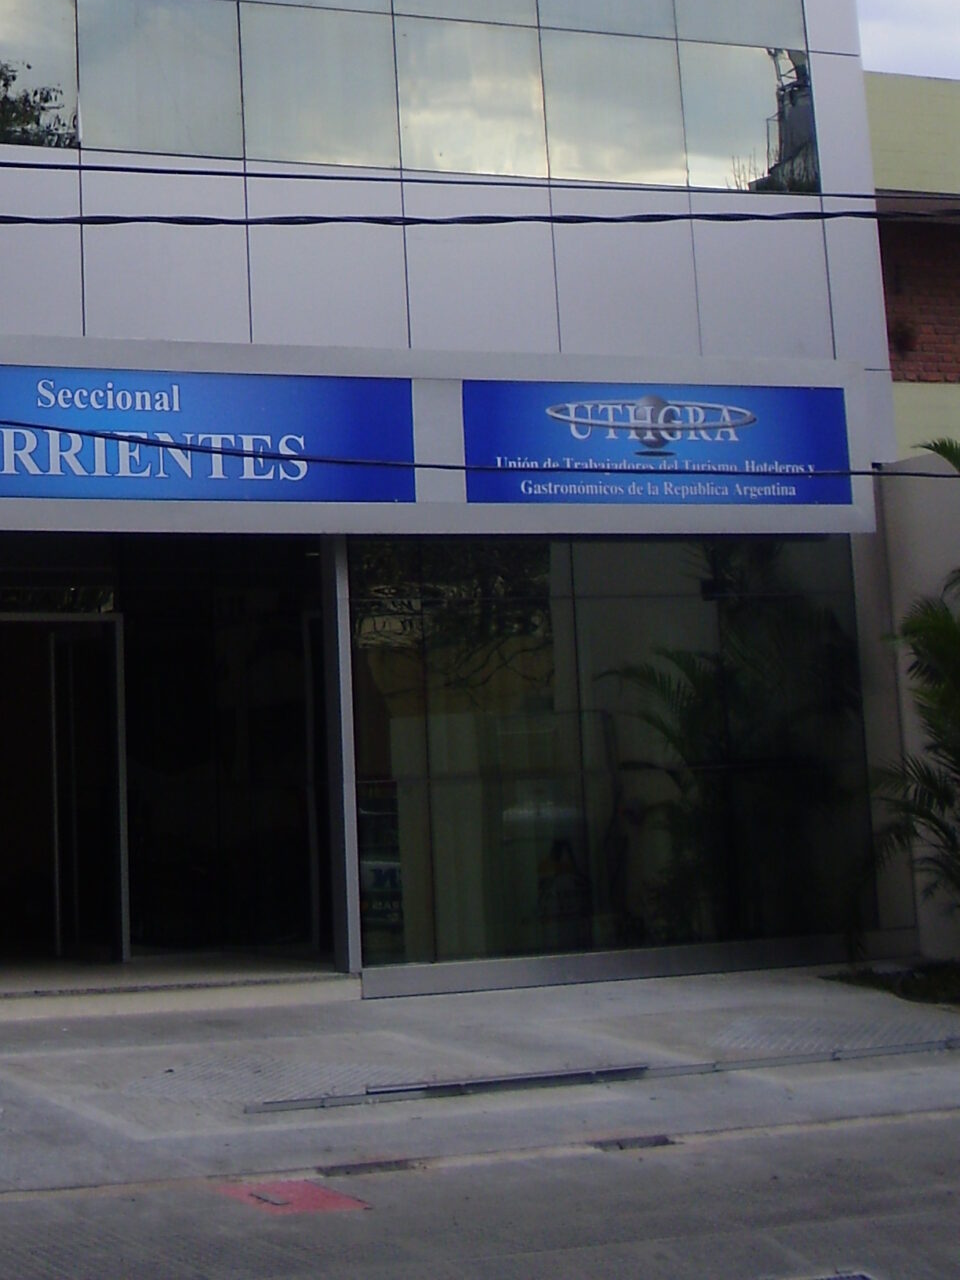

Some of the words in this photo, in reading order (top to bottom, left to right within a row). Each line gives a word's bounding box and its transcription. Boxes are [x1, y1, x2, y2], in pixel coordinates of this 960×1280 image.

[37, 380, 180, 412] Seccional
[566, 404, 740, 442] UTHGRA
[543, 457, 560, 469] de
[807, 464, 815, 478] y
[520, 479, 624, 495] Gastronómicos
[628, 481, 643, 495] de
[647, 482, 659, 495] la
[664, 481, 729, 499] República
[734, 482, 796, 499] Argentina
